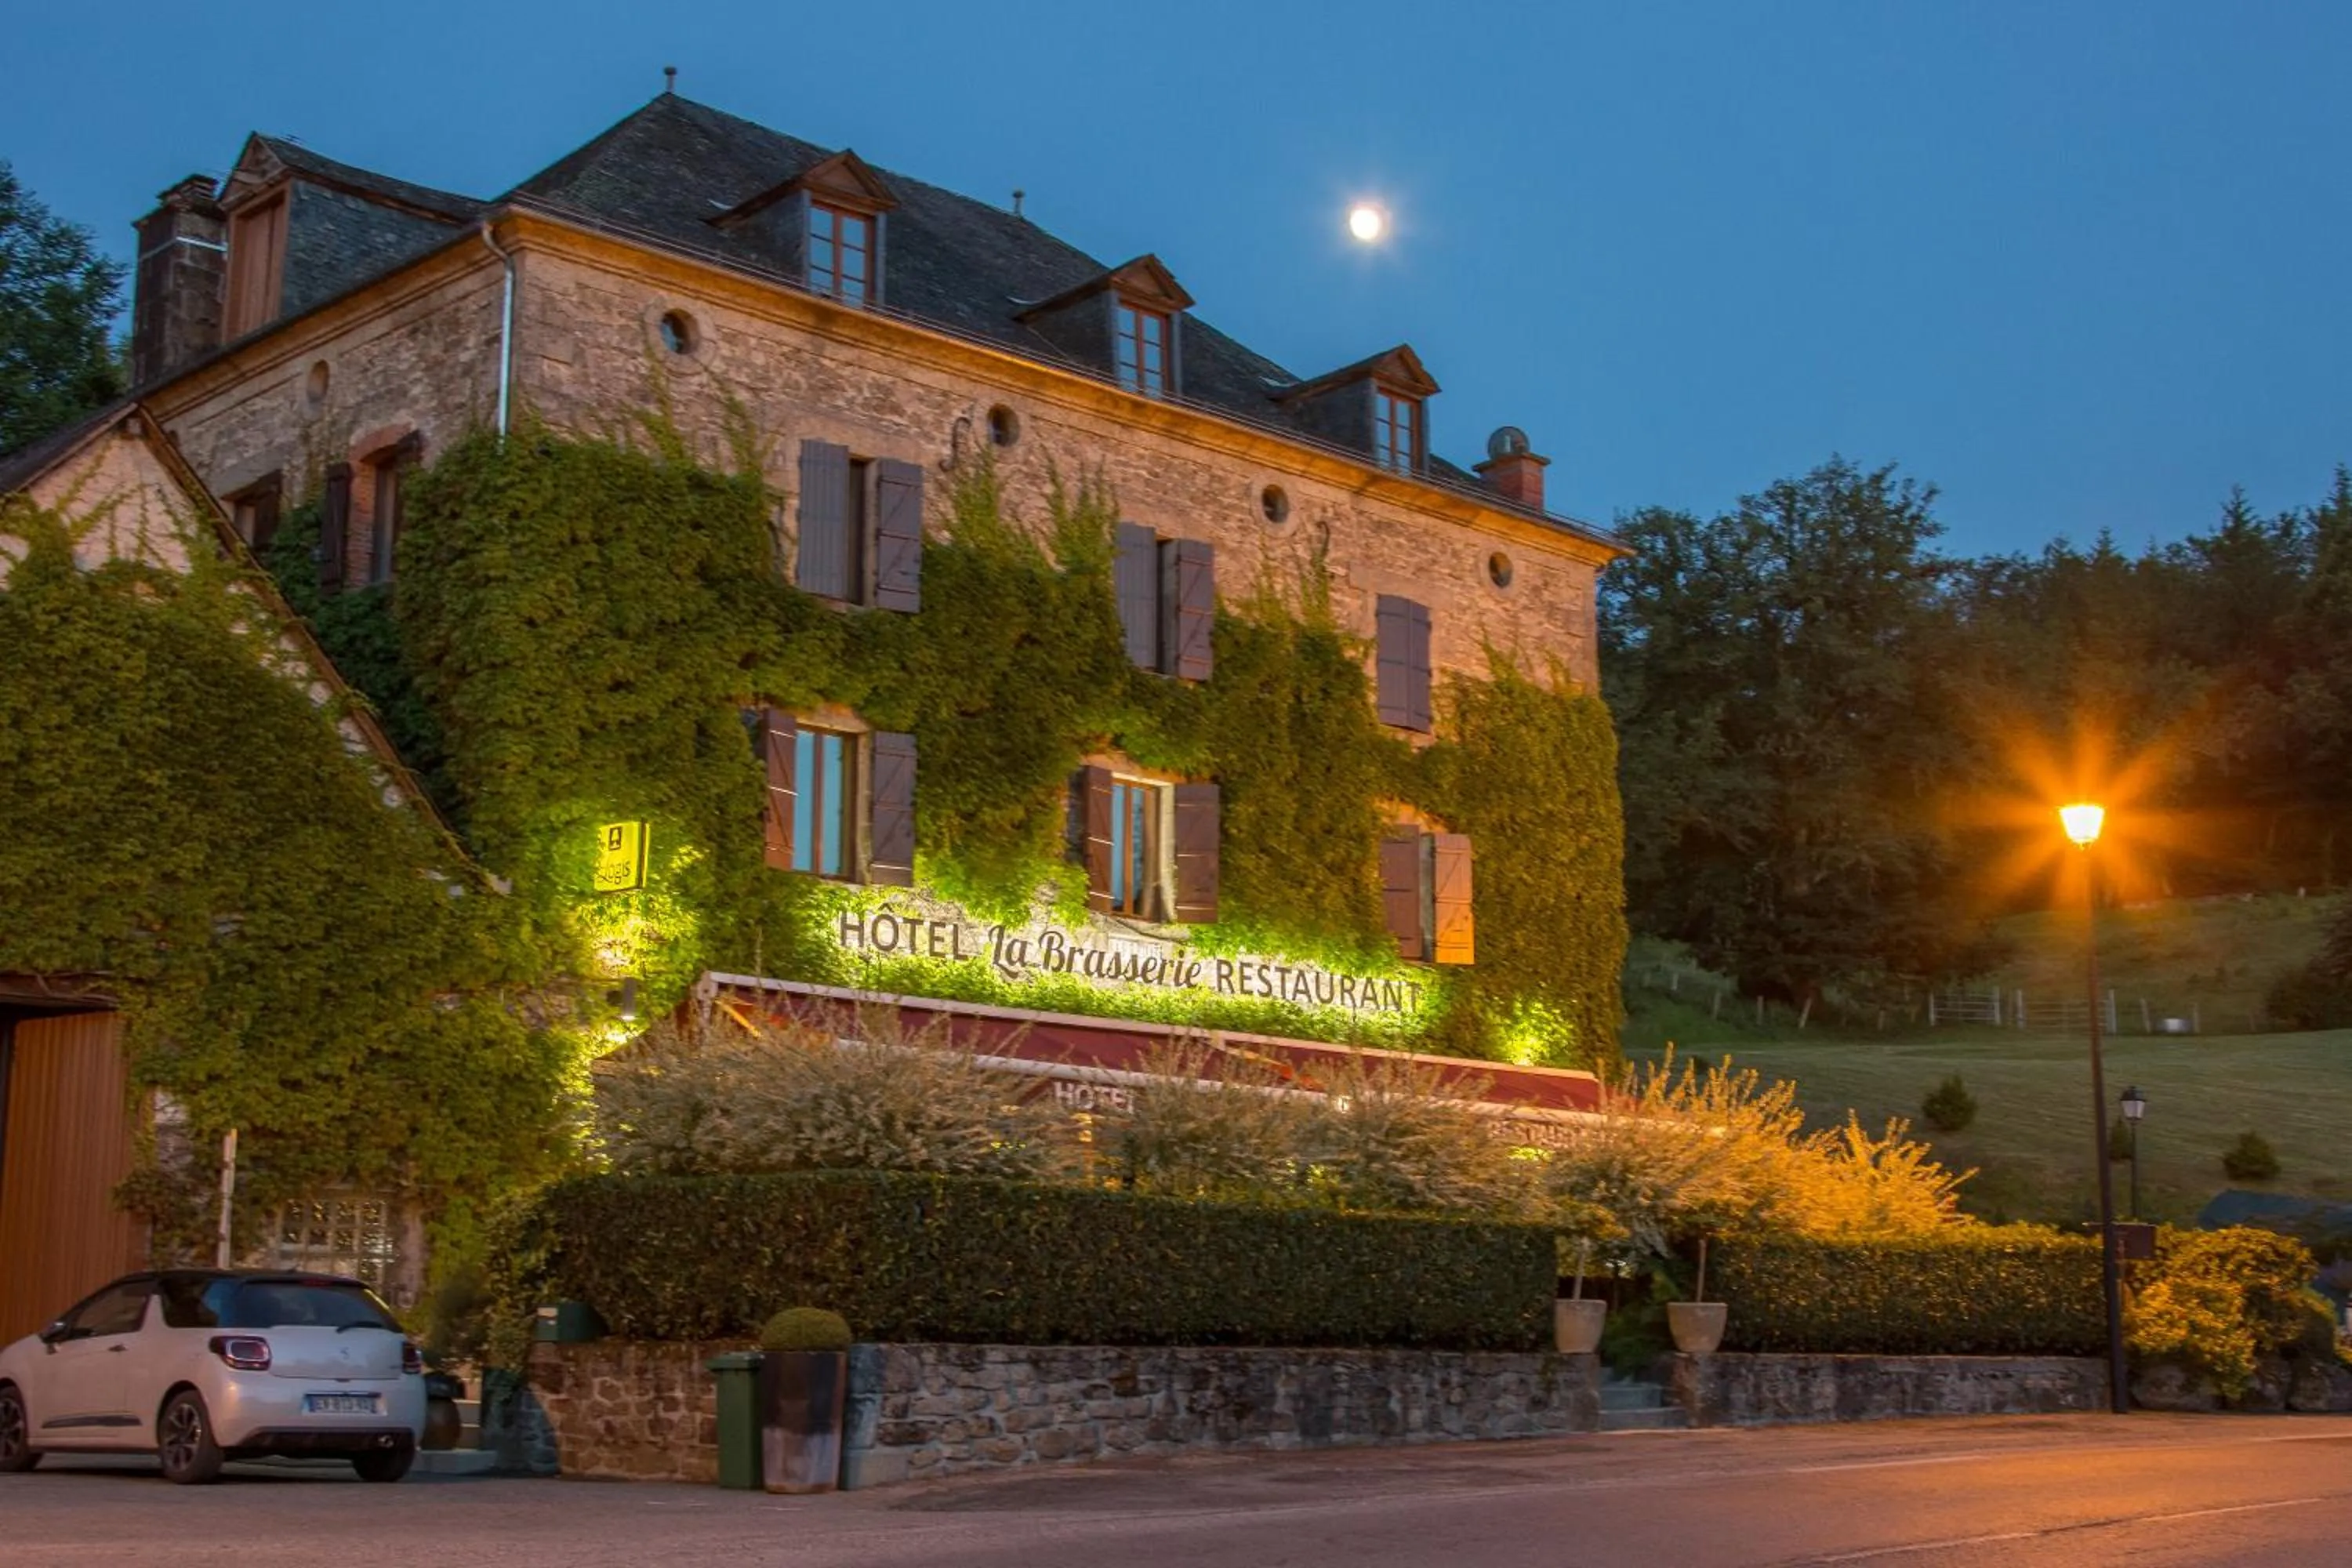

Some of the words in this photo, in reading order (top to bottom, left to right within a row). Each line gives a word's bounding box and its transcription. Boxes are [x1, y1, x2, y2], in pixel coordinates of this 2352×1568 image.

[840, 902, 969, 960] HÔTEL
[988, 925, 1029, 979] La
[1038, 931, 1202, 988] Brasserie
[1216, 959, 1423, 1012] RESTAURANT
